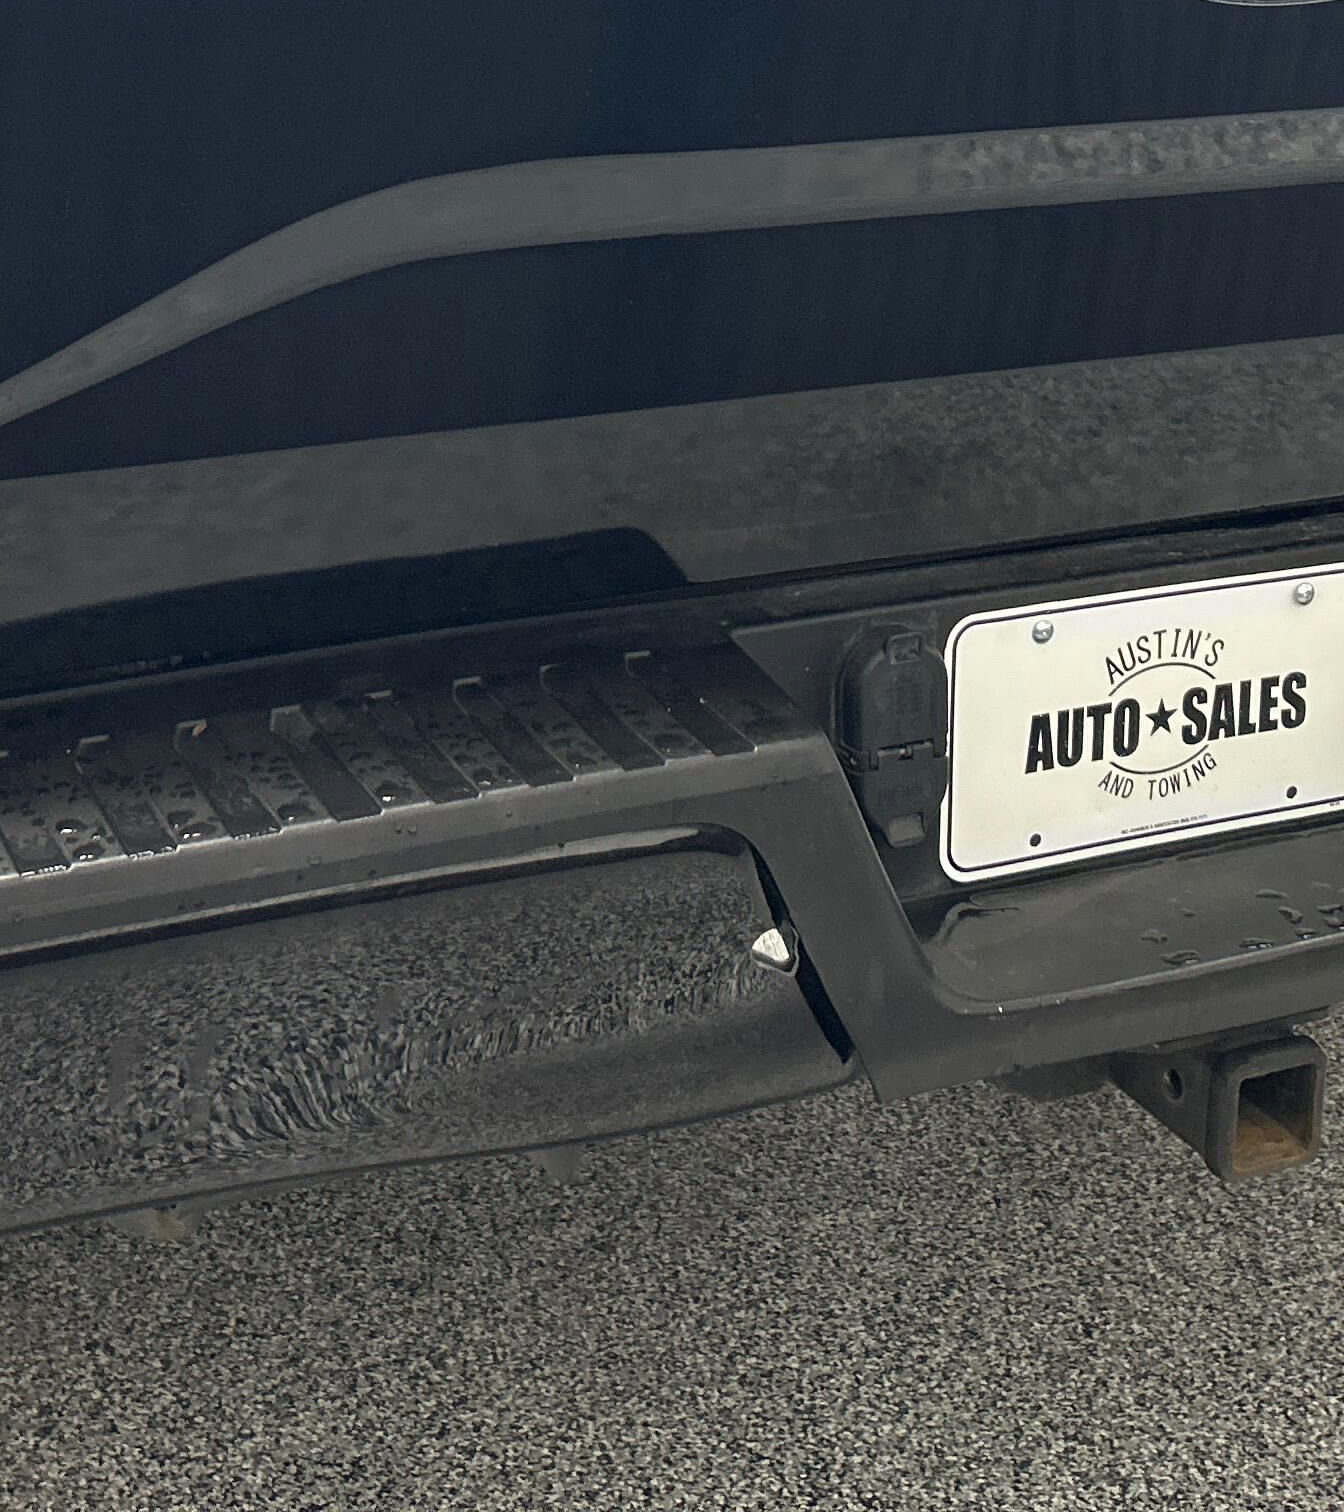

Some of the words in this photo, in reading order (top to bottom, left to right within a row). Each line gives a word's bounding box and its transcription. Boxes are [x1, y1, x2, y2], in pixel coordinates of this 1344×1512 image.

[1104, 628, 1225, 685] AUSTIN'S
[1024, 697, 1141, 775] AUTO
[1181, 671, 1308, 746] SALES
[1098, 769, 1135, 800] AND
[1148, 752, 1217, 801] TOWING
